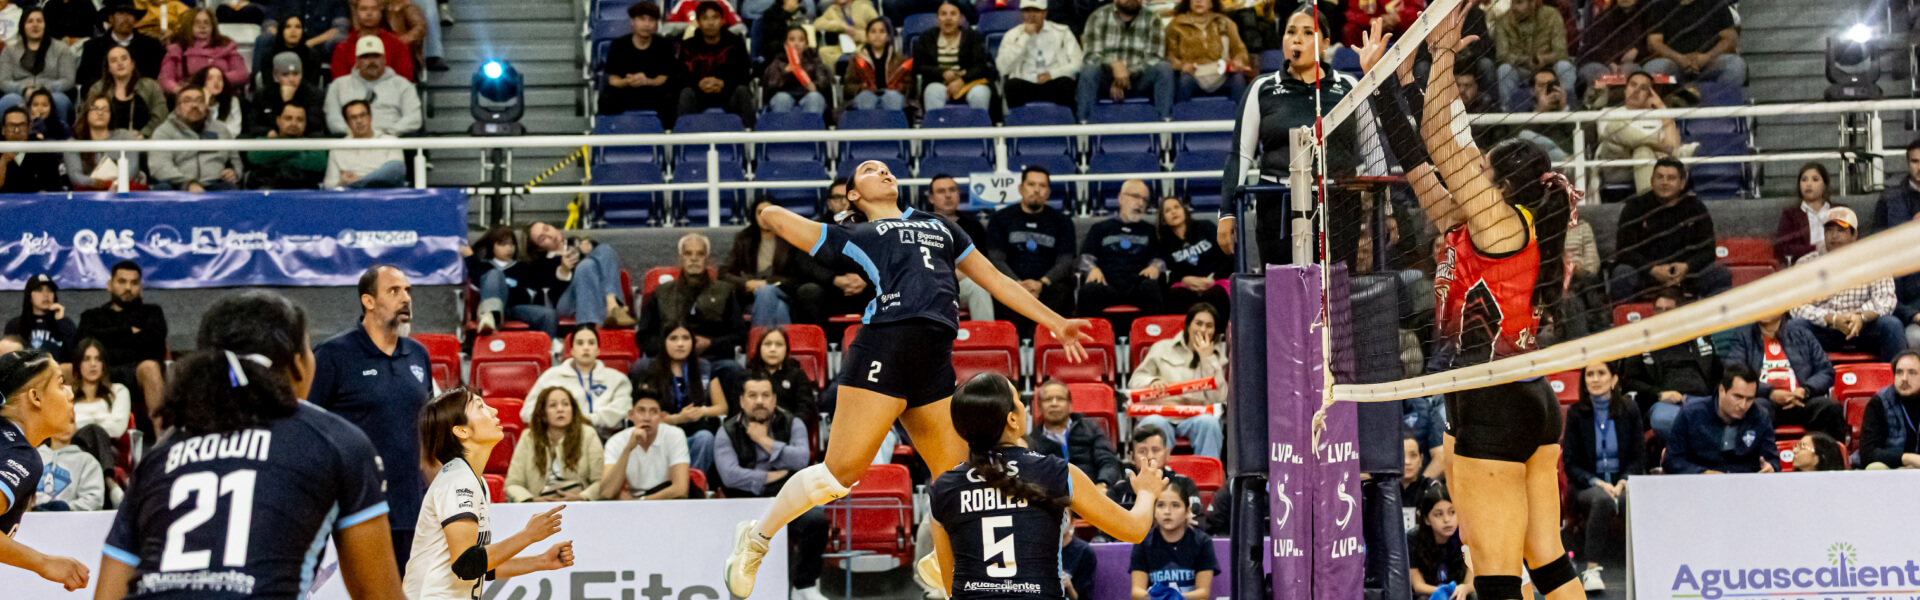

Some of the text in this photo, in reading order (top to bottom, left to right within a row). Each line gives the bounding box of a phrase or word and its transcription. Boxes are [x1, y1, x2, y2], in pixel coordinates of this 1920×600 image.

[991, 178, 1014, 188] VIP
[999, 191, 1007, 204] 2
[73, 229, 135, 254] QAS
[917, 231, 944, 241] gigante
[920, 246, 935, 271] 2
[868, 361, 882, 383] 2
[164, 429, 272, 474] BROWN
[160, 469, 257, 573] 21
[981, 515, 1018, 578] 5
[964, 579, 1041, 590] Aguascalientes
